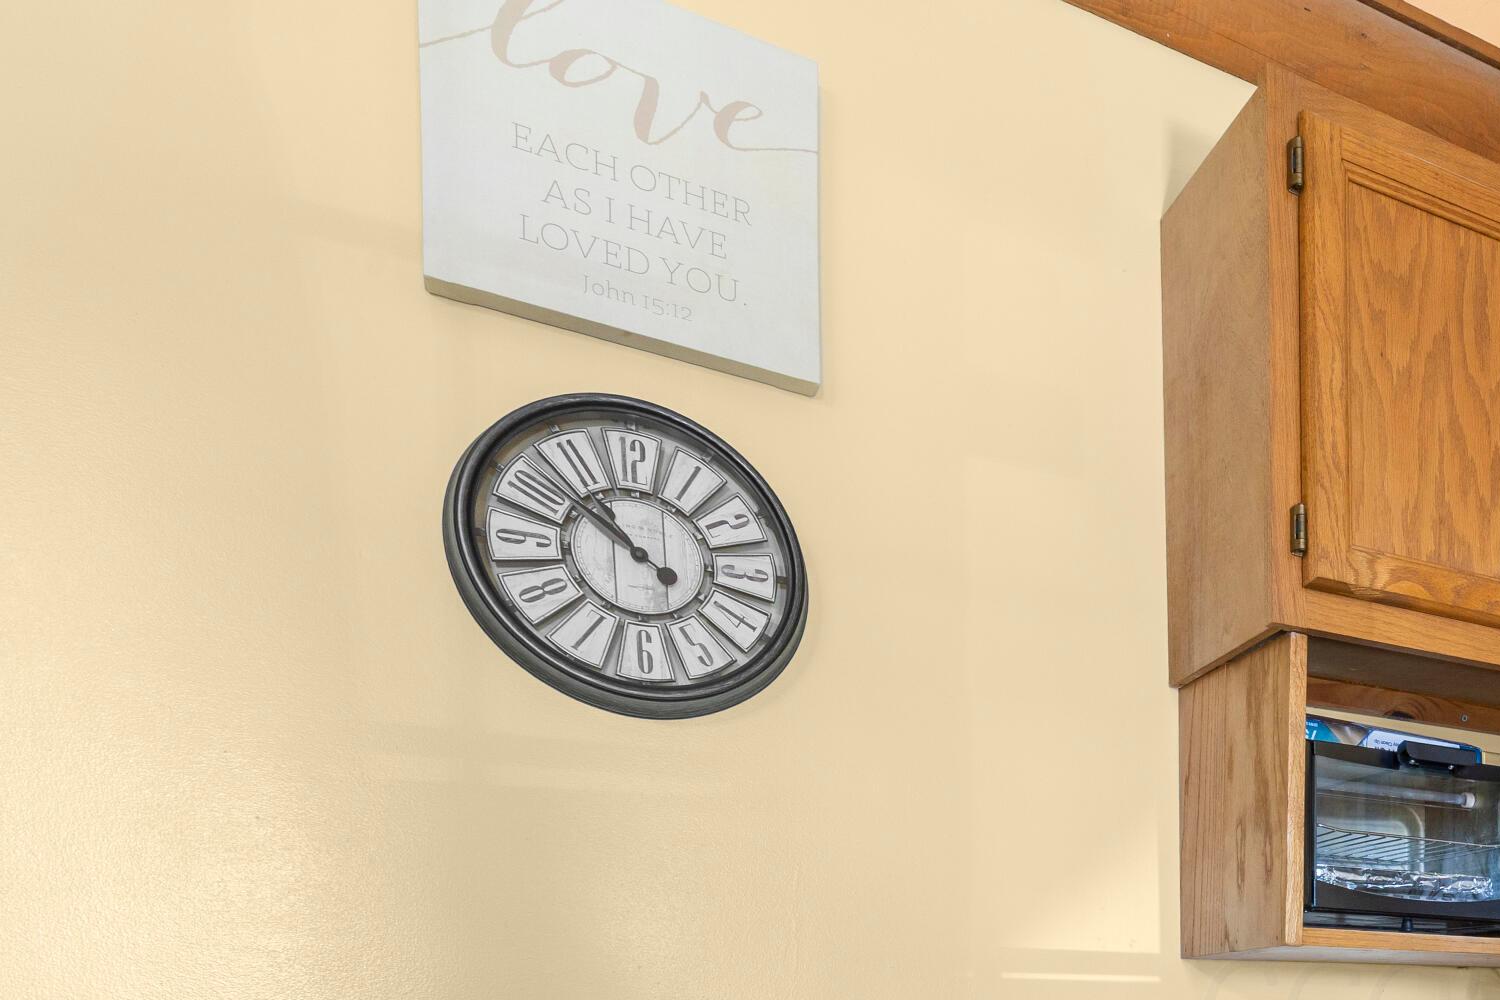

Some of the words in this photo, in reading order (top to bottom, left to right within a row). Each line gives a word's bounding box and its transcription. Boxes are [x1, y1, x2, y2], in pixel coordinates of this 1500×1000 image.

[440, 0, 790, 152] love
[511, 121, 618, 182] EACH
[630, 164, 752, 226] OTHER
[542, 179, 592, 216] AS
[605, 197, 615, 225] I
[627, 204, 728, 259] HAVE
[519, 213, 651, 276] LOVED
[659, 256, 748, 307] YOU.
[583, 274, 635, 306] John
[643, 294, 693, 323] 15:12
[556, 438, 600, 489] 11
[618, 436, 648, 486] 12
[506, 469, 566, 516] 10
[675, 466, 702, 502] 1
[495, 527, 552, 548] 9
[704, 513, 750, 539] 2
[518, 577, 568, 603] 8
[720, 563, 769, 583] 3
[571, 609, 607, 650] 7
[712, 600, 758, 632] 4
[637, 629, 654, 674] 6
[678, 624, 714, 667] 5
